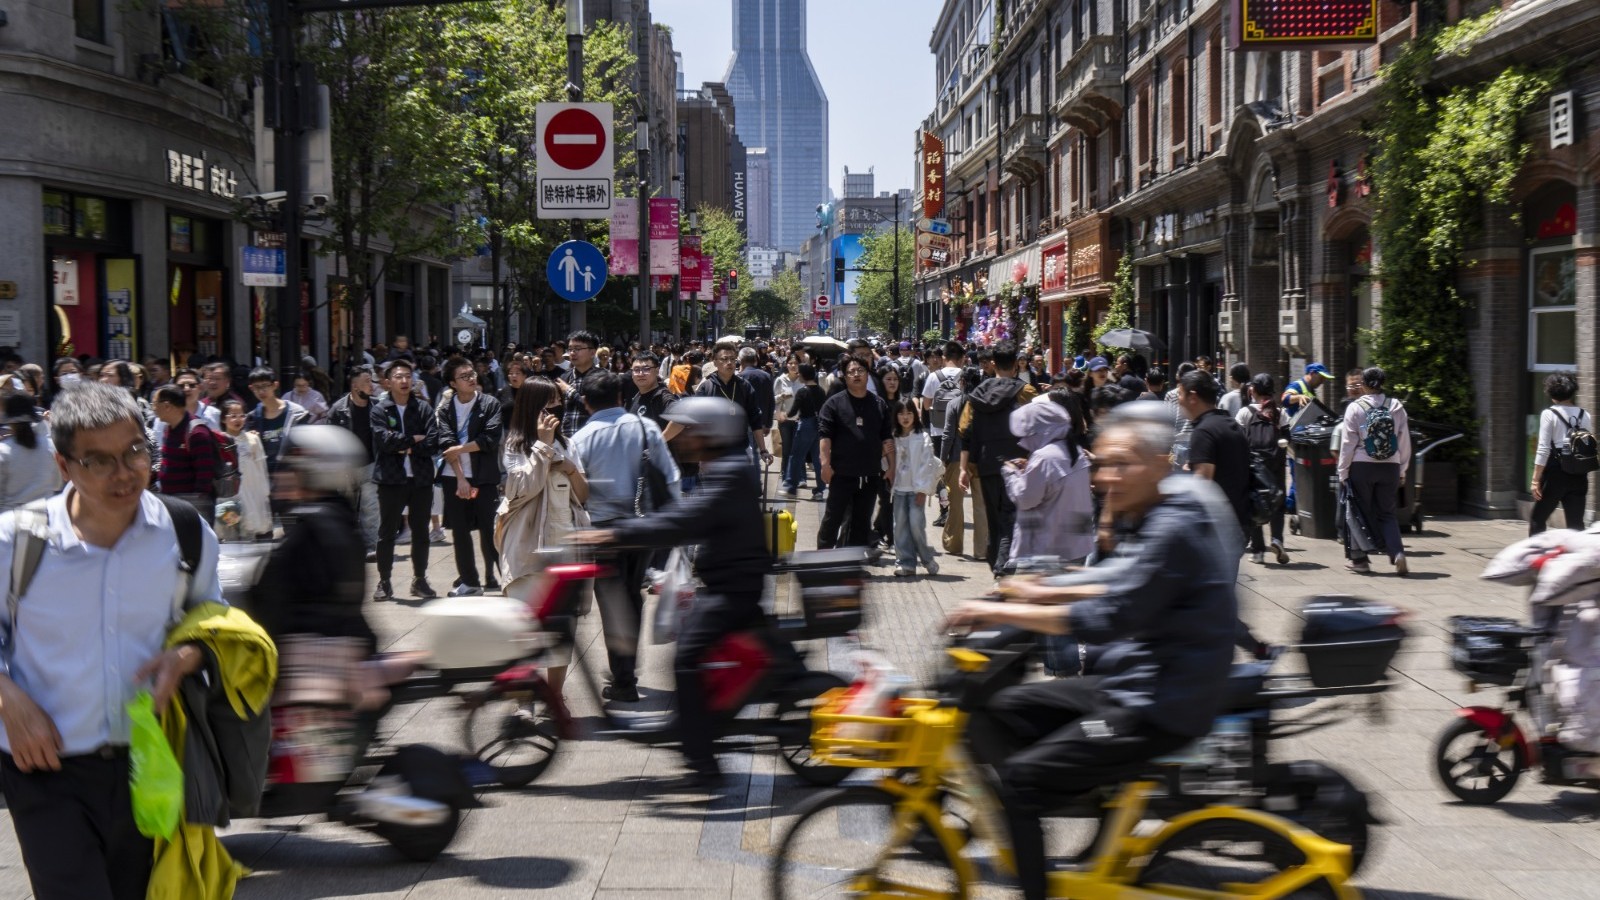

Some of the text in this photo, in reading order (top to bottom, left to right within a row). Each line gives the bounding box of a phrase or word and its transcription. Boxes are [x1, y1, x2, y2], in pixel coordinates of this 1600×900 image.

[168, 149, 238, 198] PEZ 皮礼士
[544, 185, 607, 203] 除特种车辆外
[926, 151, 942, 201] 稻香村
